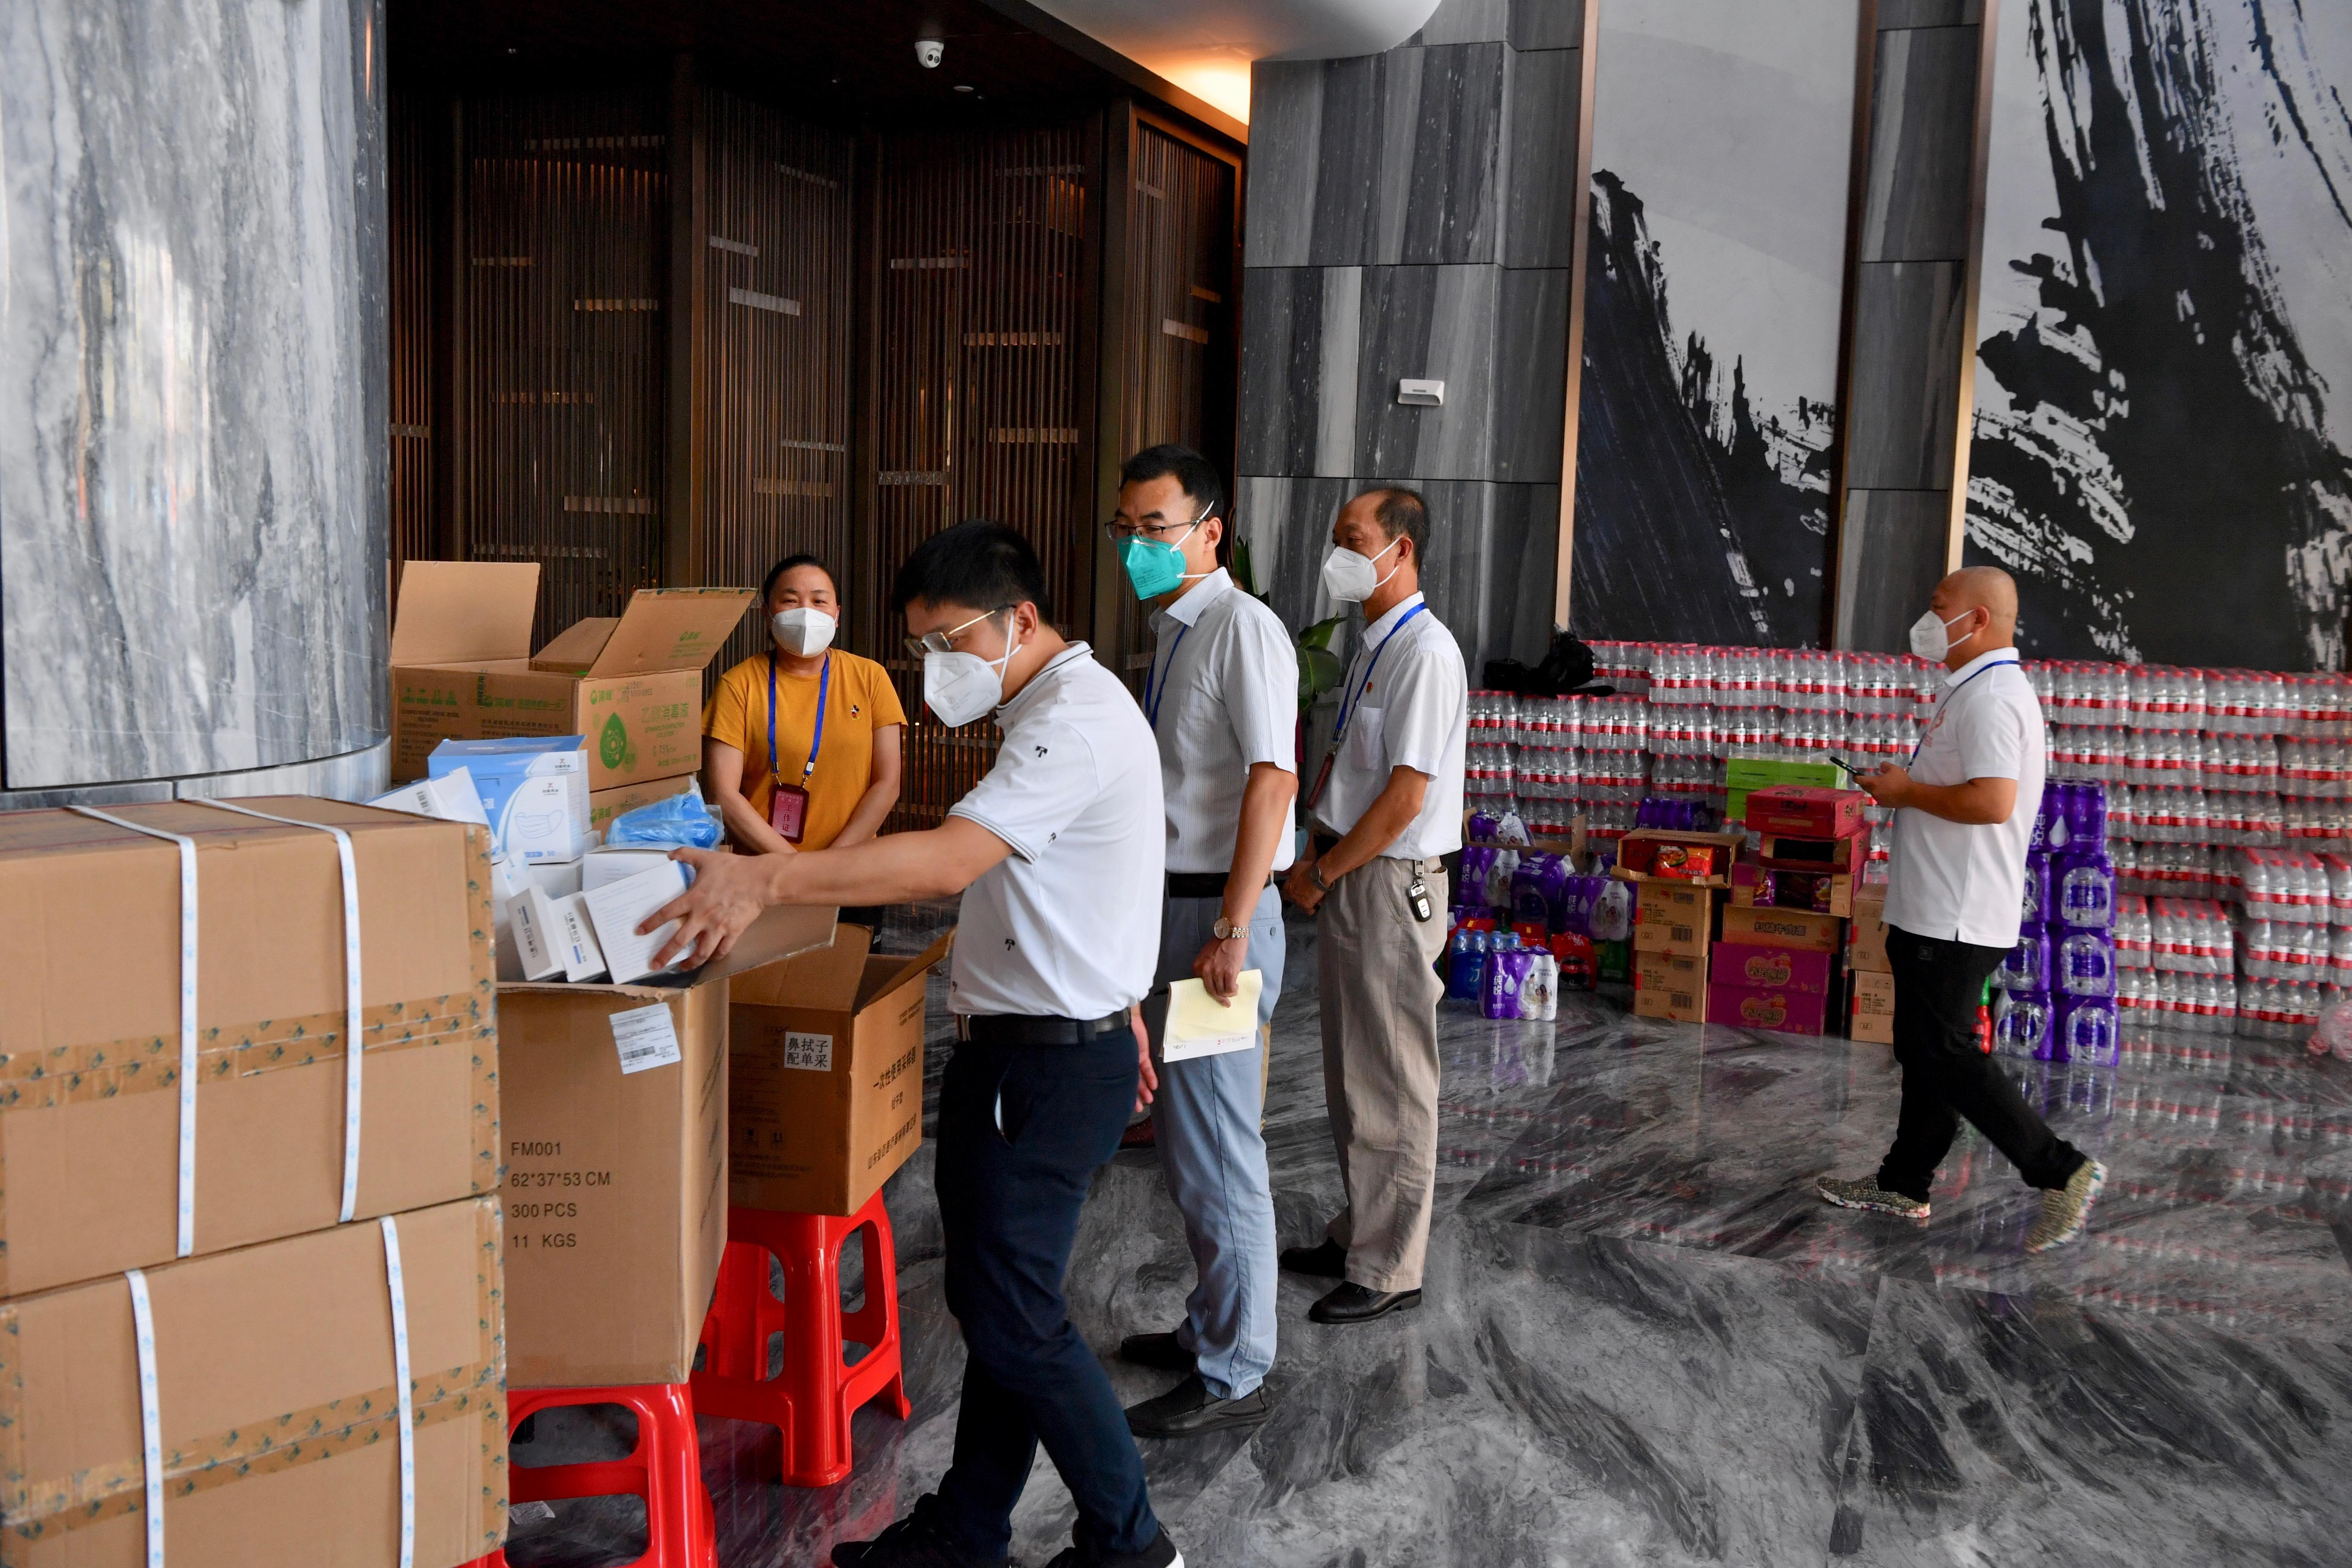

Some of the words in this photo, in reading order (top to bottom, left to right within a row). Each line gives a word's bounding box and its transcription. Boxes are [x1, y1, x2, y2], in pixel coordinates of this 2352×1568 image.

[781, 804, 792, 832] 工作证
[1461, 864, 1470, 883] 纯悦
[1566, 894, 1577, 914] 纯悦
[1754, 921, 1807, 936] 红烧牛肉面
[1493, 975, 1503, 995] 纯悦
[787, 1037, 828, 1053] 鼻拭子
[787, 1052, 828, 1068] 配单采
[873, 1045, 916, 1089] 一次性使用采样器
[511, 1142, 561, 1156] FM001
[585, 1171, 610, 1186] CM
[511, 1204, 539, 1218] 300
[544, 1203, 577, 1217] PCS
[512, 1235, 528, 1248] 11
[542, 1233, 577, 1248] KGS
